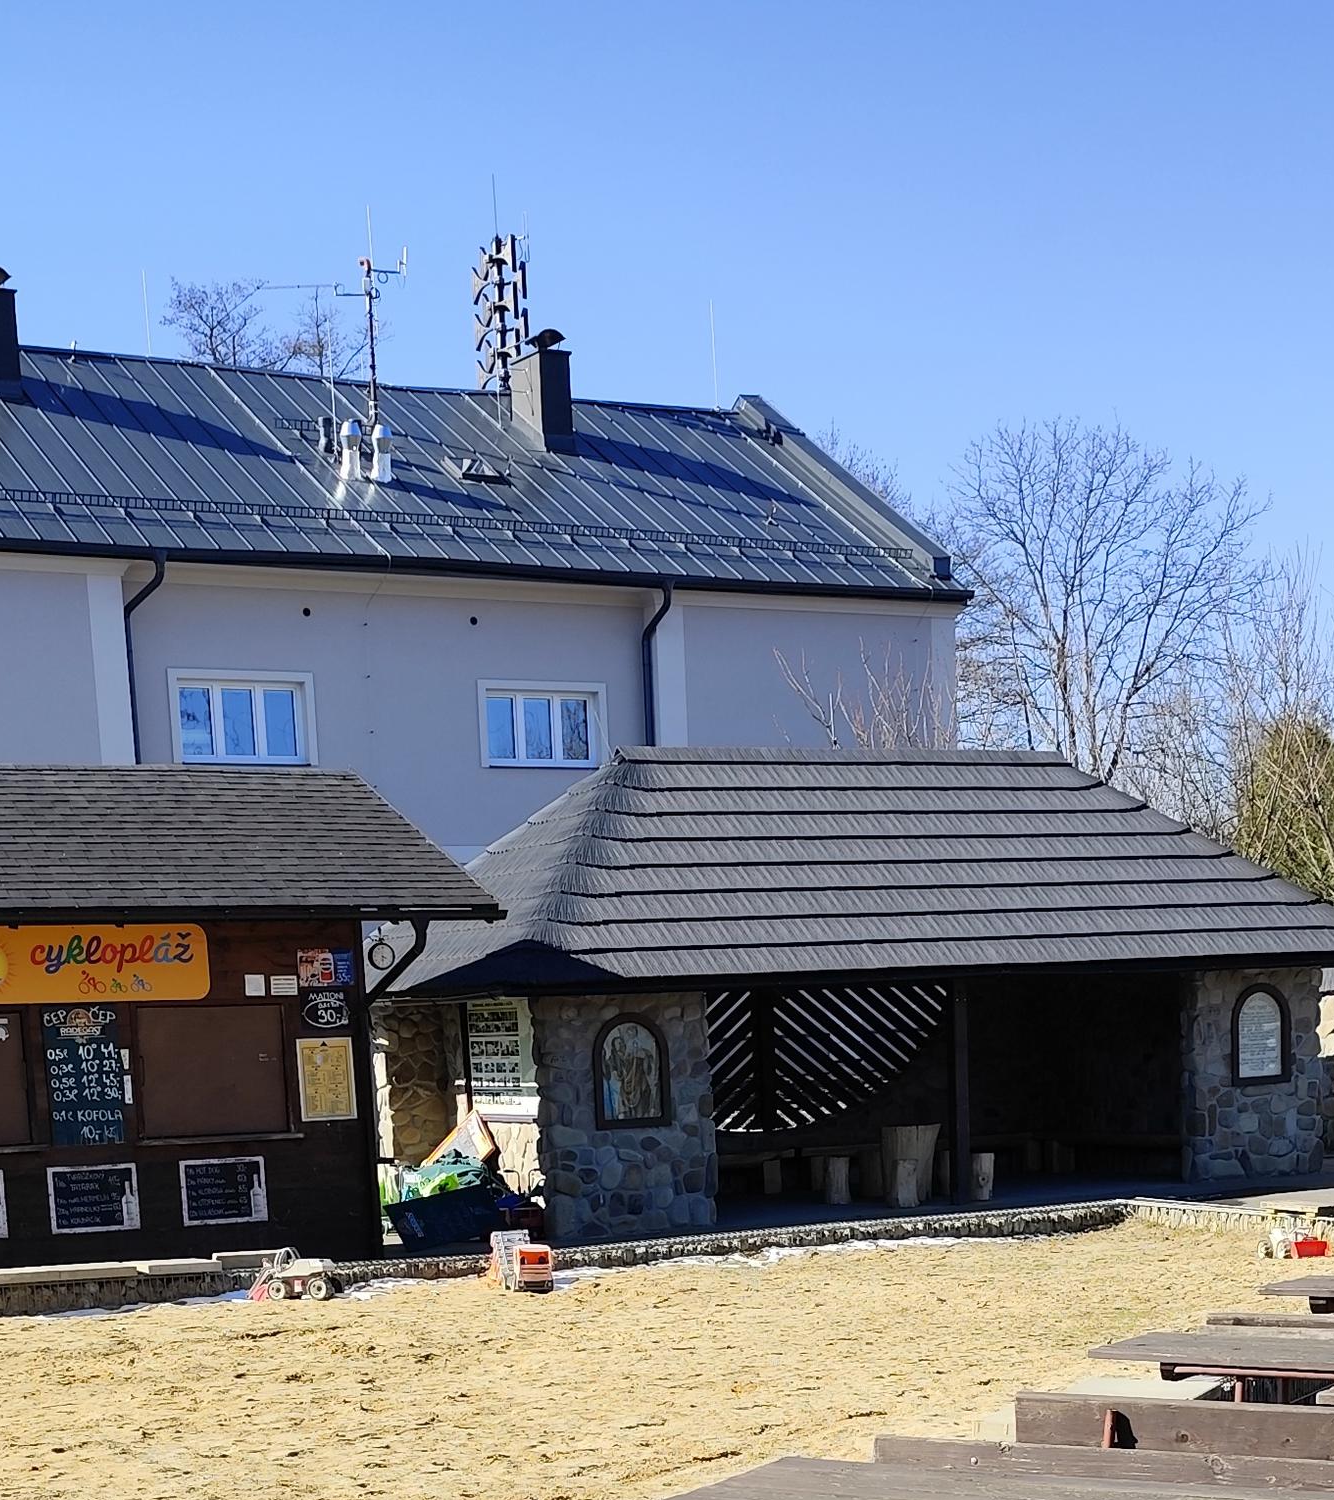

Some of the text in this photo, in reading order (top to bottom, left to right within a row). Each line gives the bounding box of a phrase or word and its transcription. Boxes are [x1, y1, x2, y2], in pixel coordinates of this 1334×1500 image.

[29, 931, 195, 975] cyklopláž
[43, 1009, 67, 1027] ČEP
[89, 1005, 116, 1024] ČEP
[59, 1026, 103, 1036] RADEGAST
[77, 1109, 124, 1122] KOFOLA
